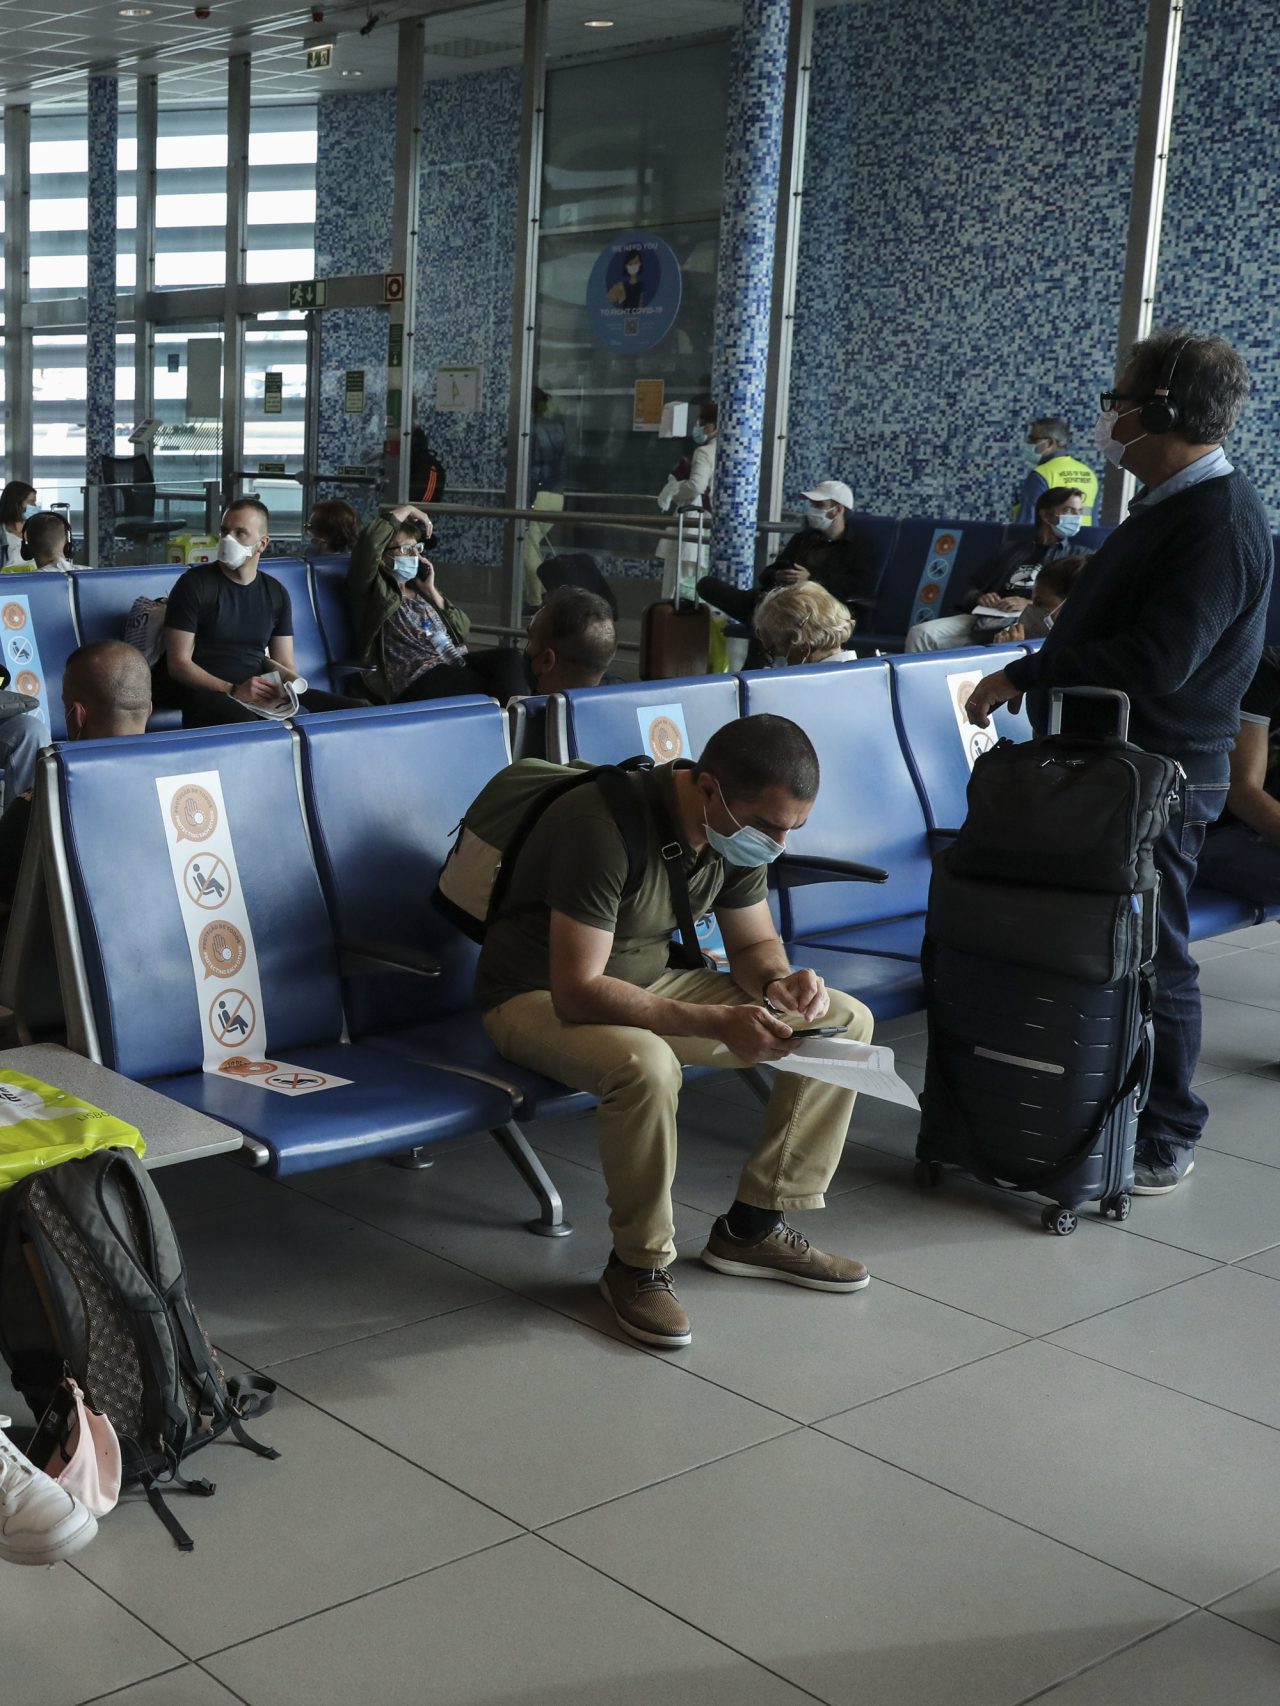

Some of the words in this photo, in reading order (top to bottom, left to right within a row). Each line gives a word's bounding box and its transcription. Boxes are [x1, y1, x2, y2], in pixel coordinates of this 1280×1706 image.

[623, 243, 643, 251] NEED
[644, 242, 658, 250] YOU
[600, 308, 609, 316] TO
[610, 307, 631, 316] FIGHT
[631, 306, 663, 315] COVID-19
